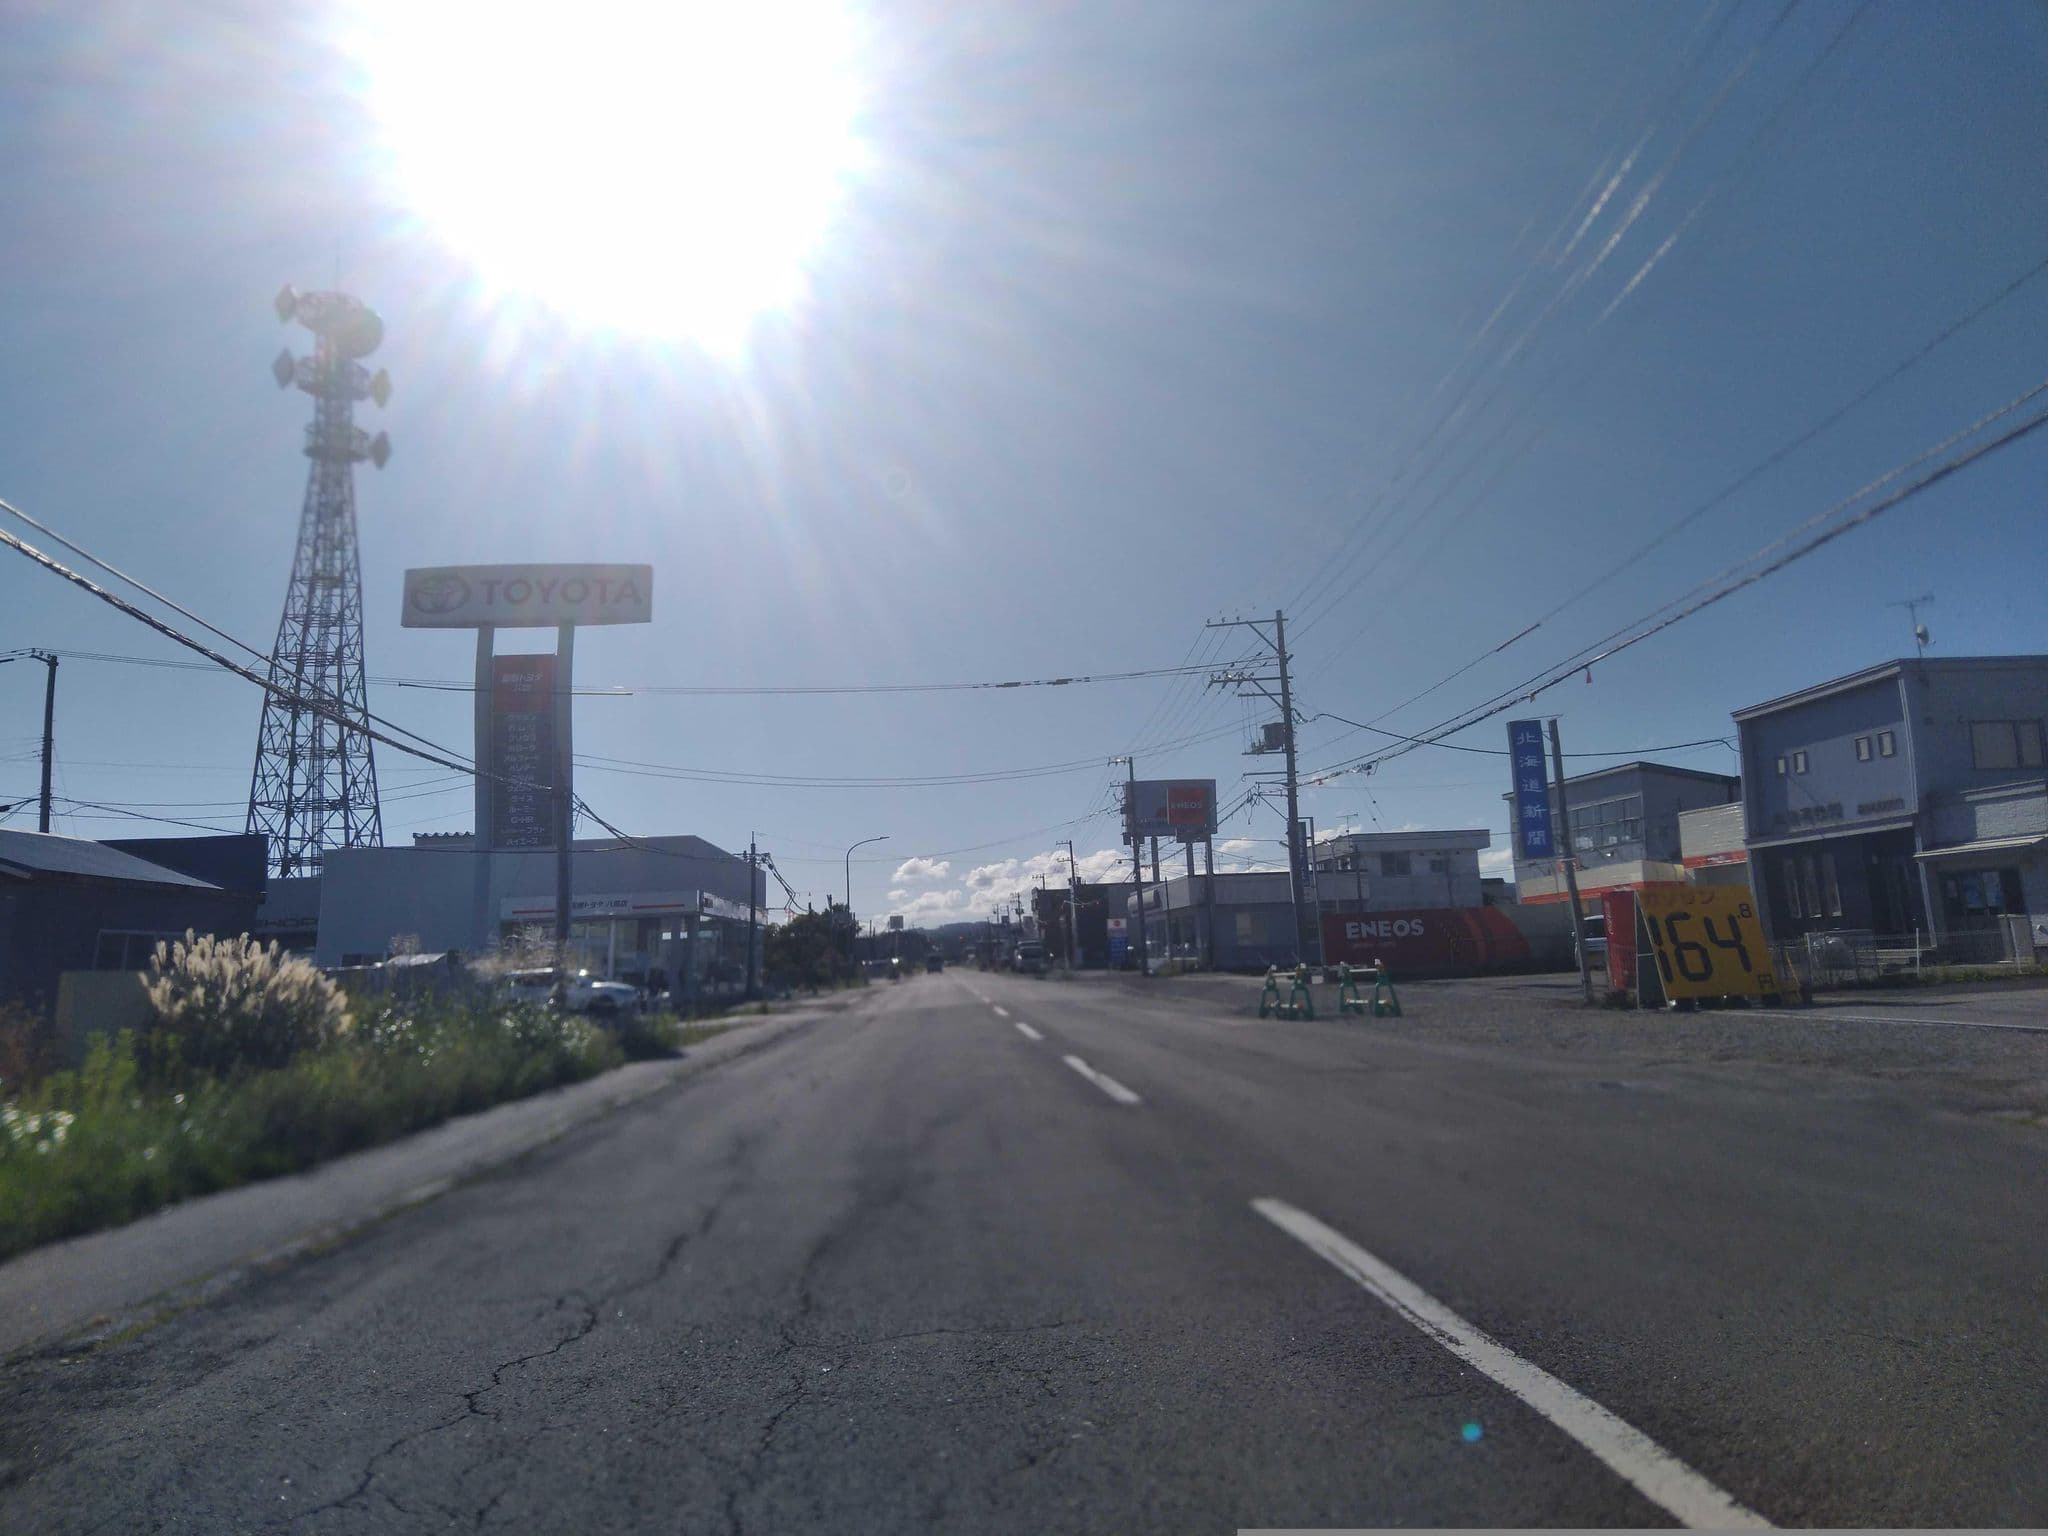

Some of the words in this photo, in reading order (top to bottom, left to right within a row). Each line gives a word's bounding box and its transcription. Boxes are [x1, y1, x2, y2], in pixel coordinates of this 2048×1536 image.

[480, 576, 641, 606] TOYOTA
[1516, 731, 1549, 847] 北海道新聞
[1345, 918, 1425, 940] ENEOS
